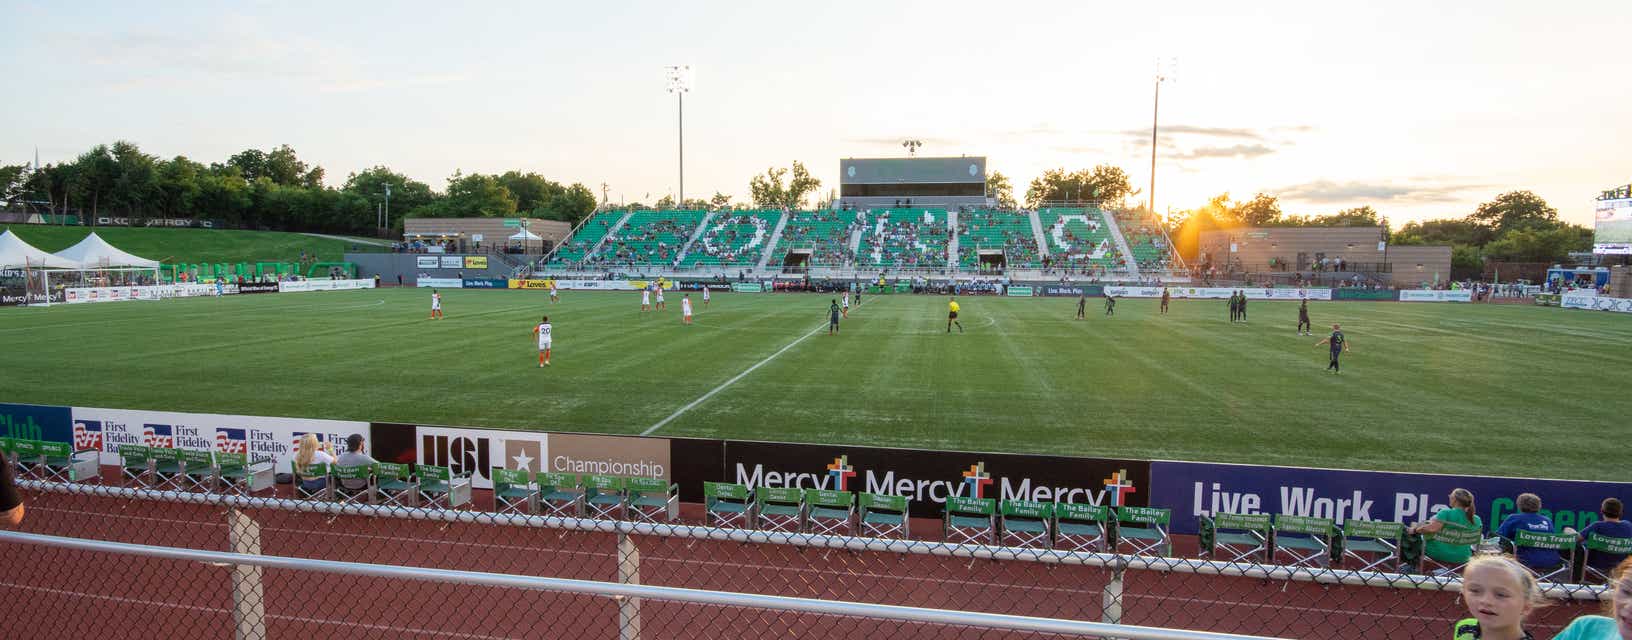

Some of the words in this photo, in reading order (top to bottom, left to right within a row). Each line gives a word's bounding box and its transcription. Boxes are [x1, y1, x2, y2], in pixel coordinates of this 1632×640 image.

[2, 294, 27, 303] Mercy
[541, 327, 551, 335] 20
[105, 421, 126, 432] First
[176, 425, 199, 437] First
[106, 433, 140, 445] Fidelity
[250, 429, 273, 441] First
[176, 437, 213, 449] Fidelity
[251, 441, 288, 455] Fidelity
[554, 455, 665, 480] Championship
[736, 462, 831, 491] Mercy
[865, 469, 966, 503] Mercy
[1000, 476, 1106, 511] Mercy
[967, 499, 990, 507] Bailey
[1023, 502, 1046, 510] Bailey
[960, 504, 982, 513] Family
[1015, 507, 1038, 516] Family
[1063, 504, 1077, 512] The
[1078, 505, 1101, 514] Bailey
[1125, 507, 1139, 515] The
[1140, 508, 1165, 517] Bailey
[1069, 511, 1094, 520] Family
[1131, 514, 1157, 523] Family
[1520, 532, 1548, 541] Loves
[1550, 535, 1576, 543] Travel
[1593, 533, 1624, 545] Loves
[1534, 541, 1561, 549] Stops
